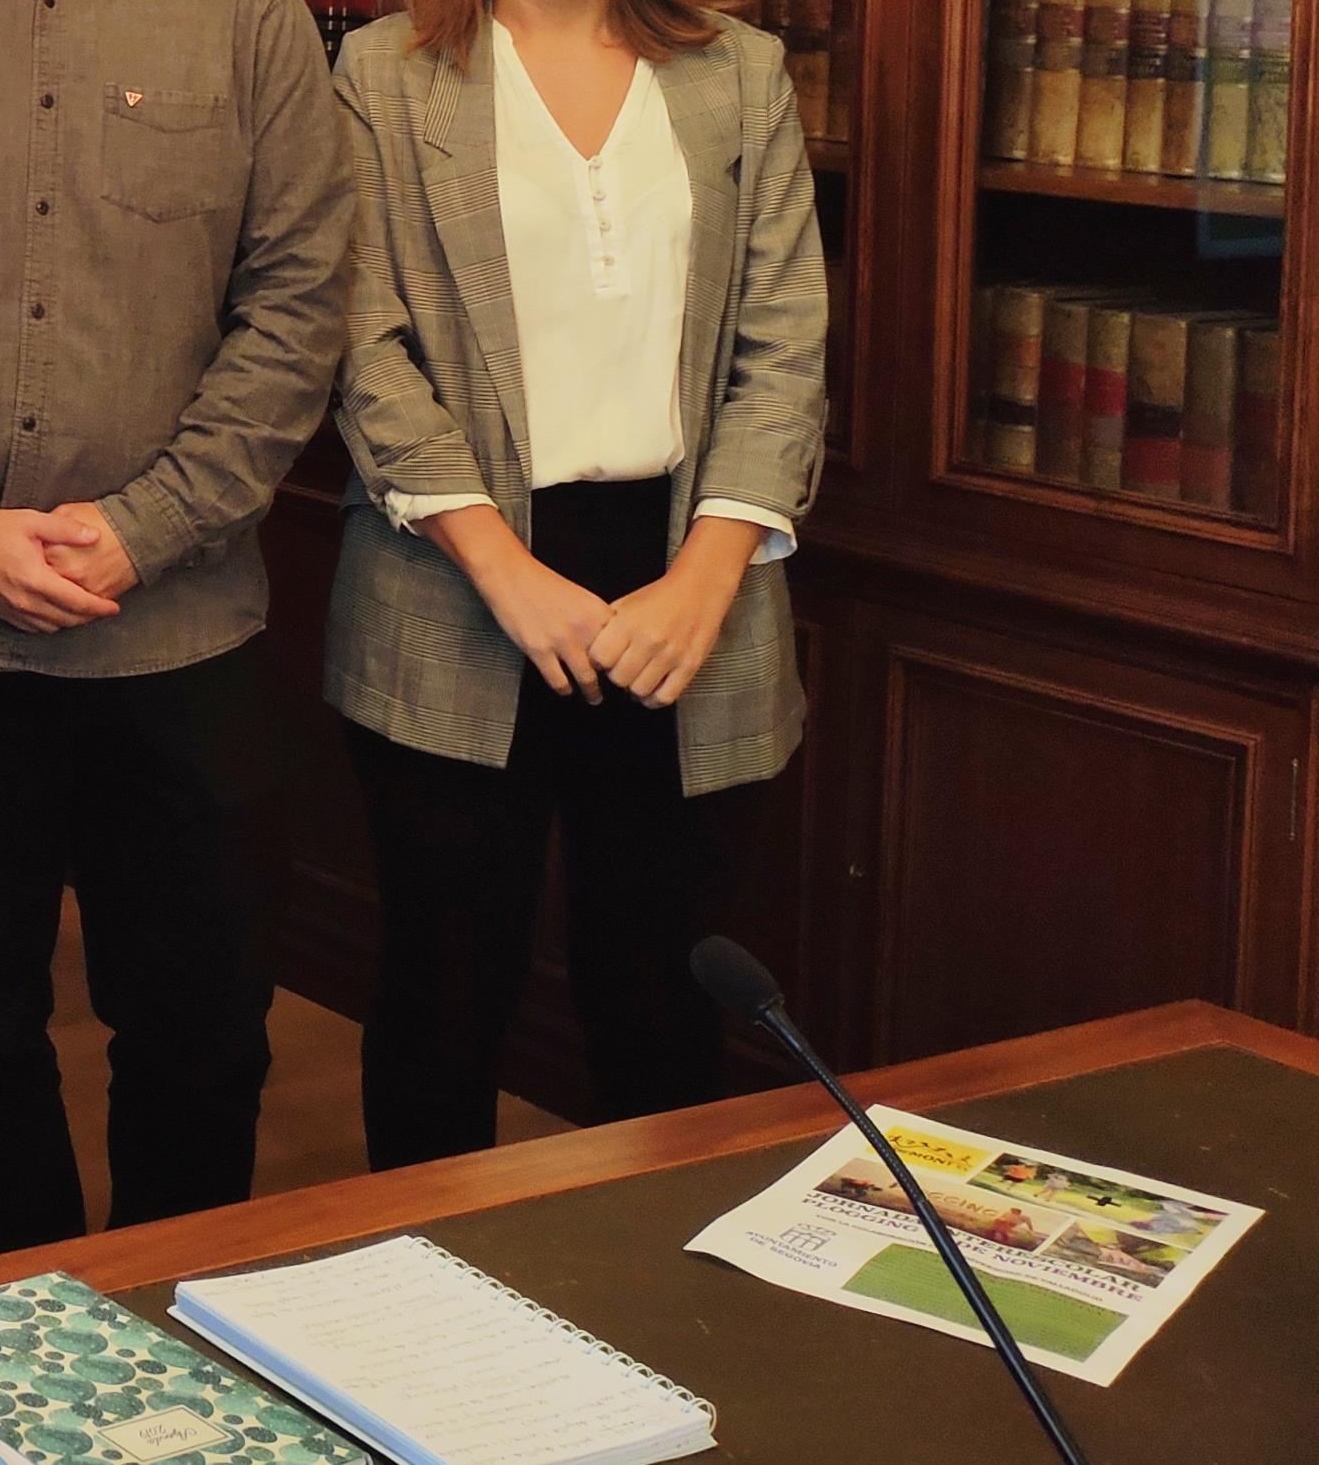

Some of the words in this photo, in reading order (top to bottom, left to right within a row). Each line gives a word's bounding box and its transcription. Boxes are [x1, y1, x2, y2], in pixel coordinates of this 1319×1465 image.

[801, 1198, 919, 1232] PLOGGING
[955, 1240, 989, 1255] DE
[993, 1253, 1143, 1302] NOVIEMBRE
[949, 1228, 1141, 1292] NTERESCOLAR
